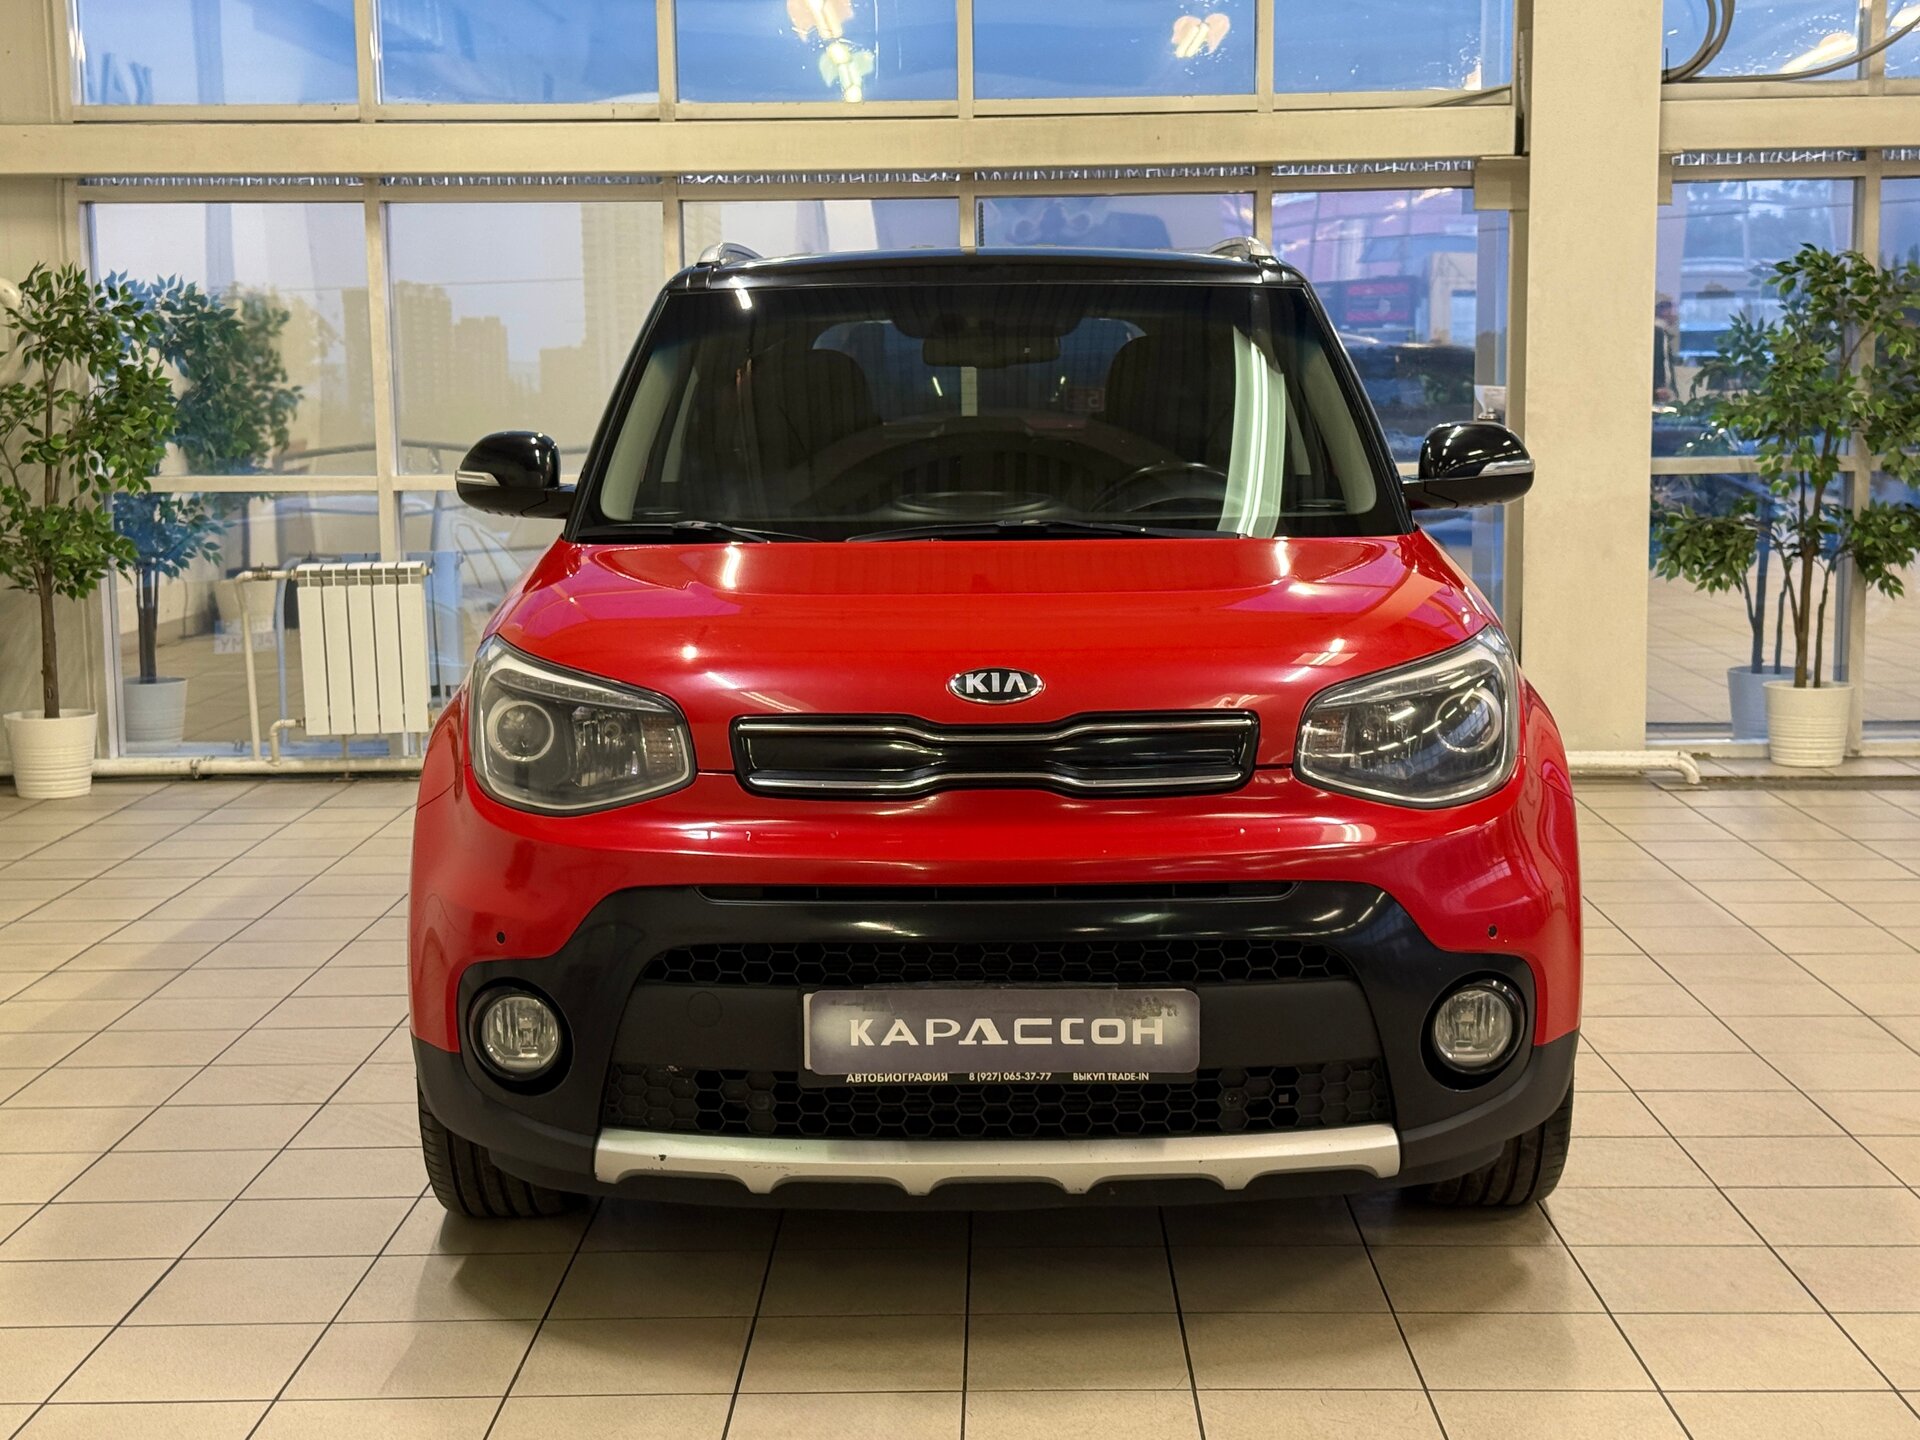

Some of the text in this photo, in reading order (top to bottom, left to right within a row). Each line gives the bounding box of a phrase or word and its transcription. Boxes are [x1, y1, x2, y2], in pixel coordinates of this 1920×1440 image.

[965, 672, 1028, 694] KIA
[846, 1072, 1150, 1083] АВТОБИОГРАФИЯ 8 (927) 065-37-77 ВЫКУП TRADE-IN
